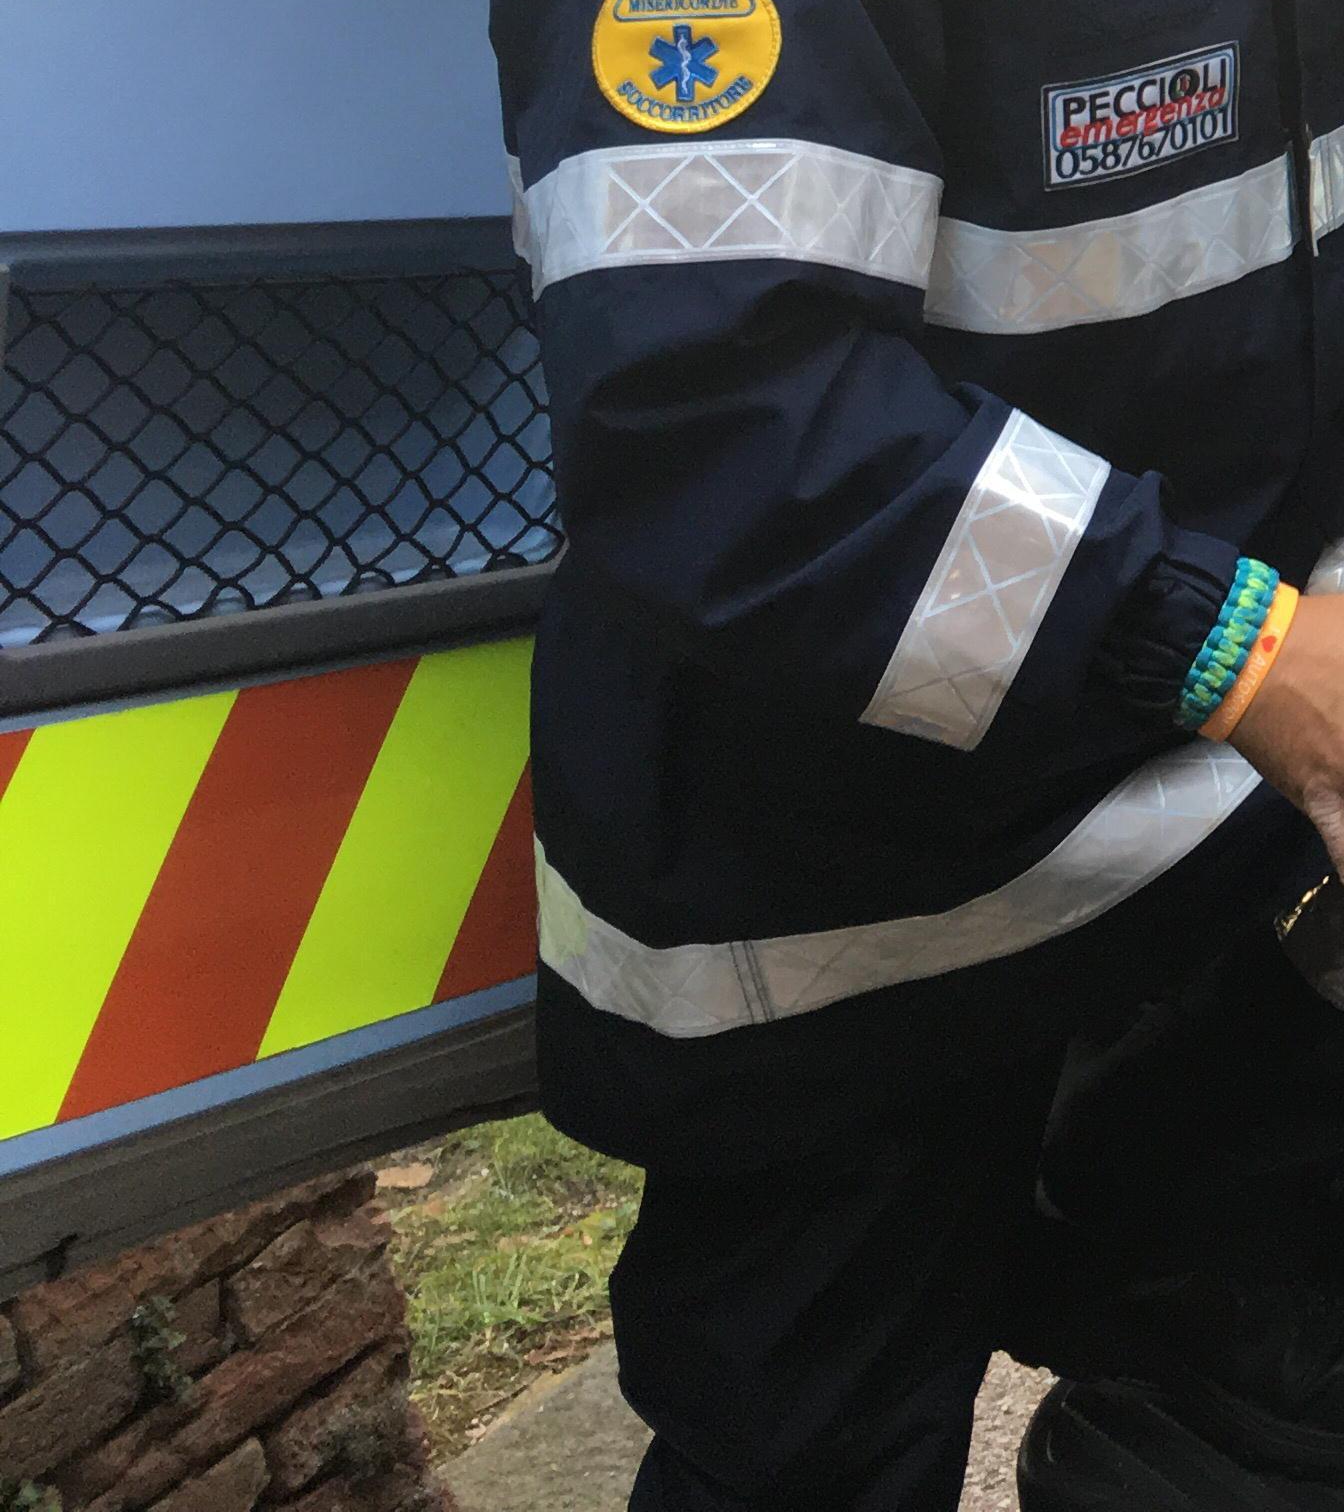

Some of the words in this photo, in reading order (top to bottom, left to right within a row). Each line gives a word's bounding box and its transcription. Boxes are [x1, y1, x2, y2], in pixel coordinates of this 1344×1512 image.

[617, 75, 754, 122] SOCCORRITORE
[1060, 87, 1225, 148] emergenza
[1062, 58, 1227, 129] PECCIOLI
[1055, 106, 1228, 179] 0587670101
